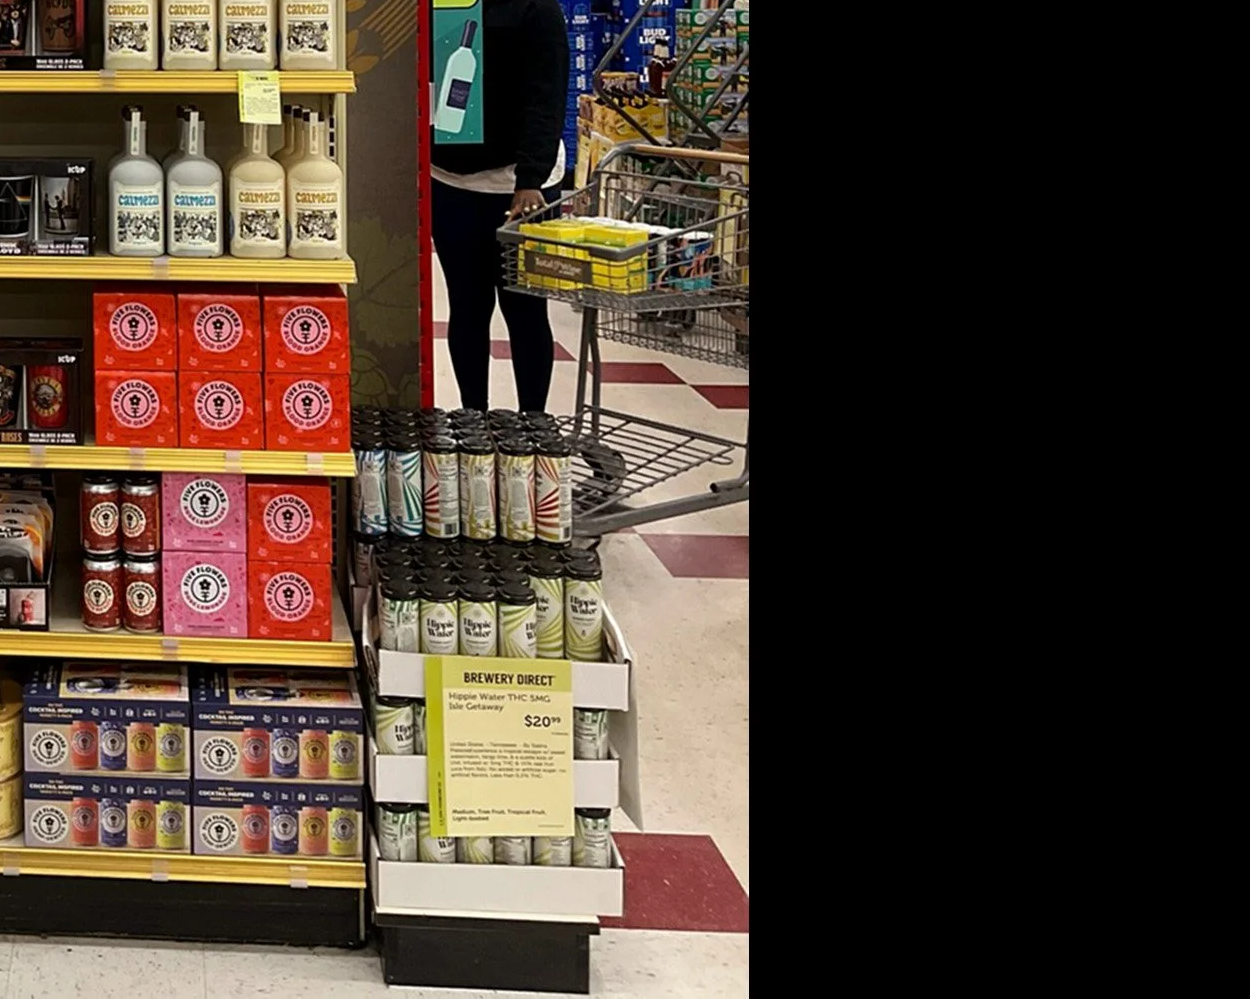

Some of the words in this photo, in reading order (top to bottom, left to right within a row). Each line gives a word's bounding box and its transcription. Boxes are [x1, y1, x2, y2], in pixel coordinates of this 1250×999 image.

[643, 28, 667, 36] BUD
[112, 306, 125, 325] FIVE
[125, 302, 156, 326] FLOWERS
[463, 672, 514, 685] BREWERY
[516, 674, 554, 687] DIRECT
[448, 692, 478, 702] Hippie
[479, 692, 506, 701] Water
[507, 694, 527, 702] THC
[448, 703, 464, 711] Isle
[466, 703, 504, 713] Getaway
